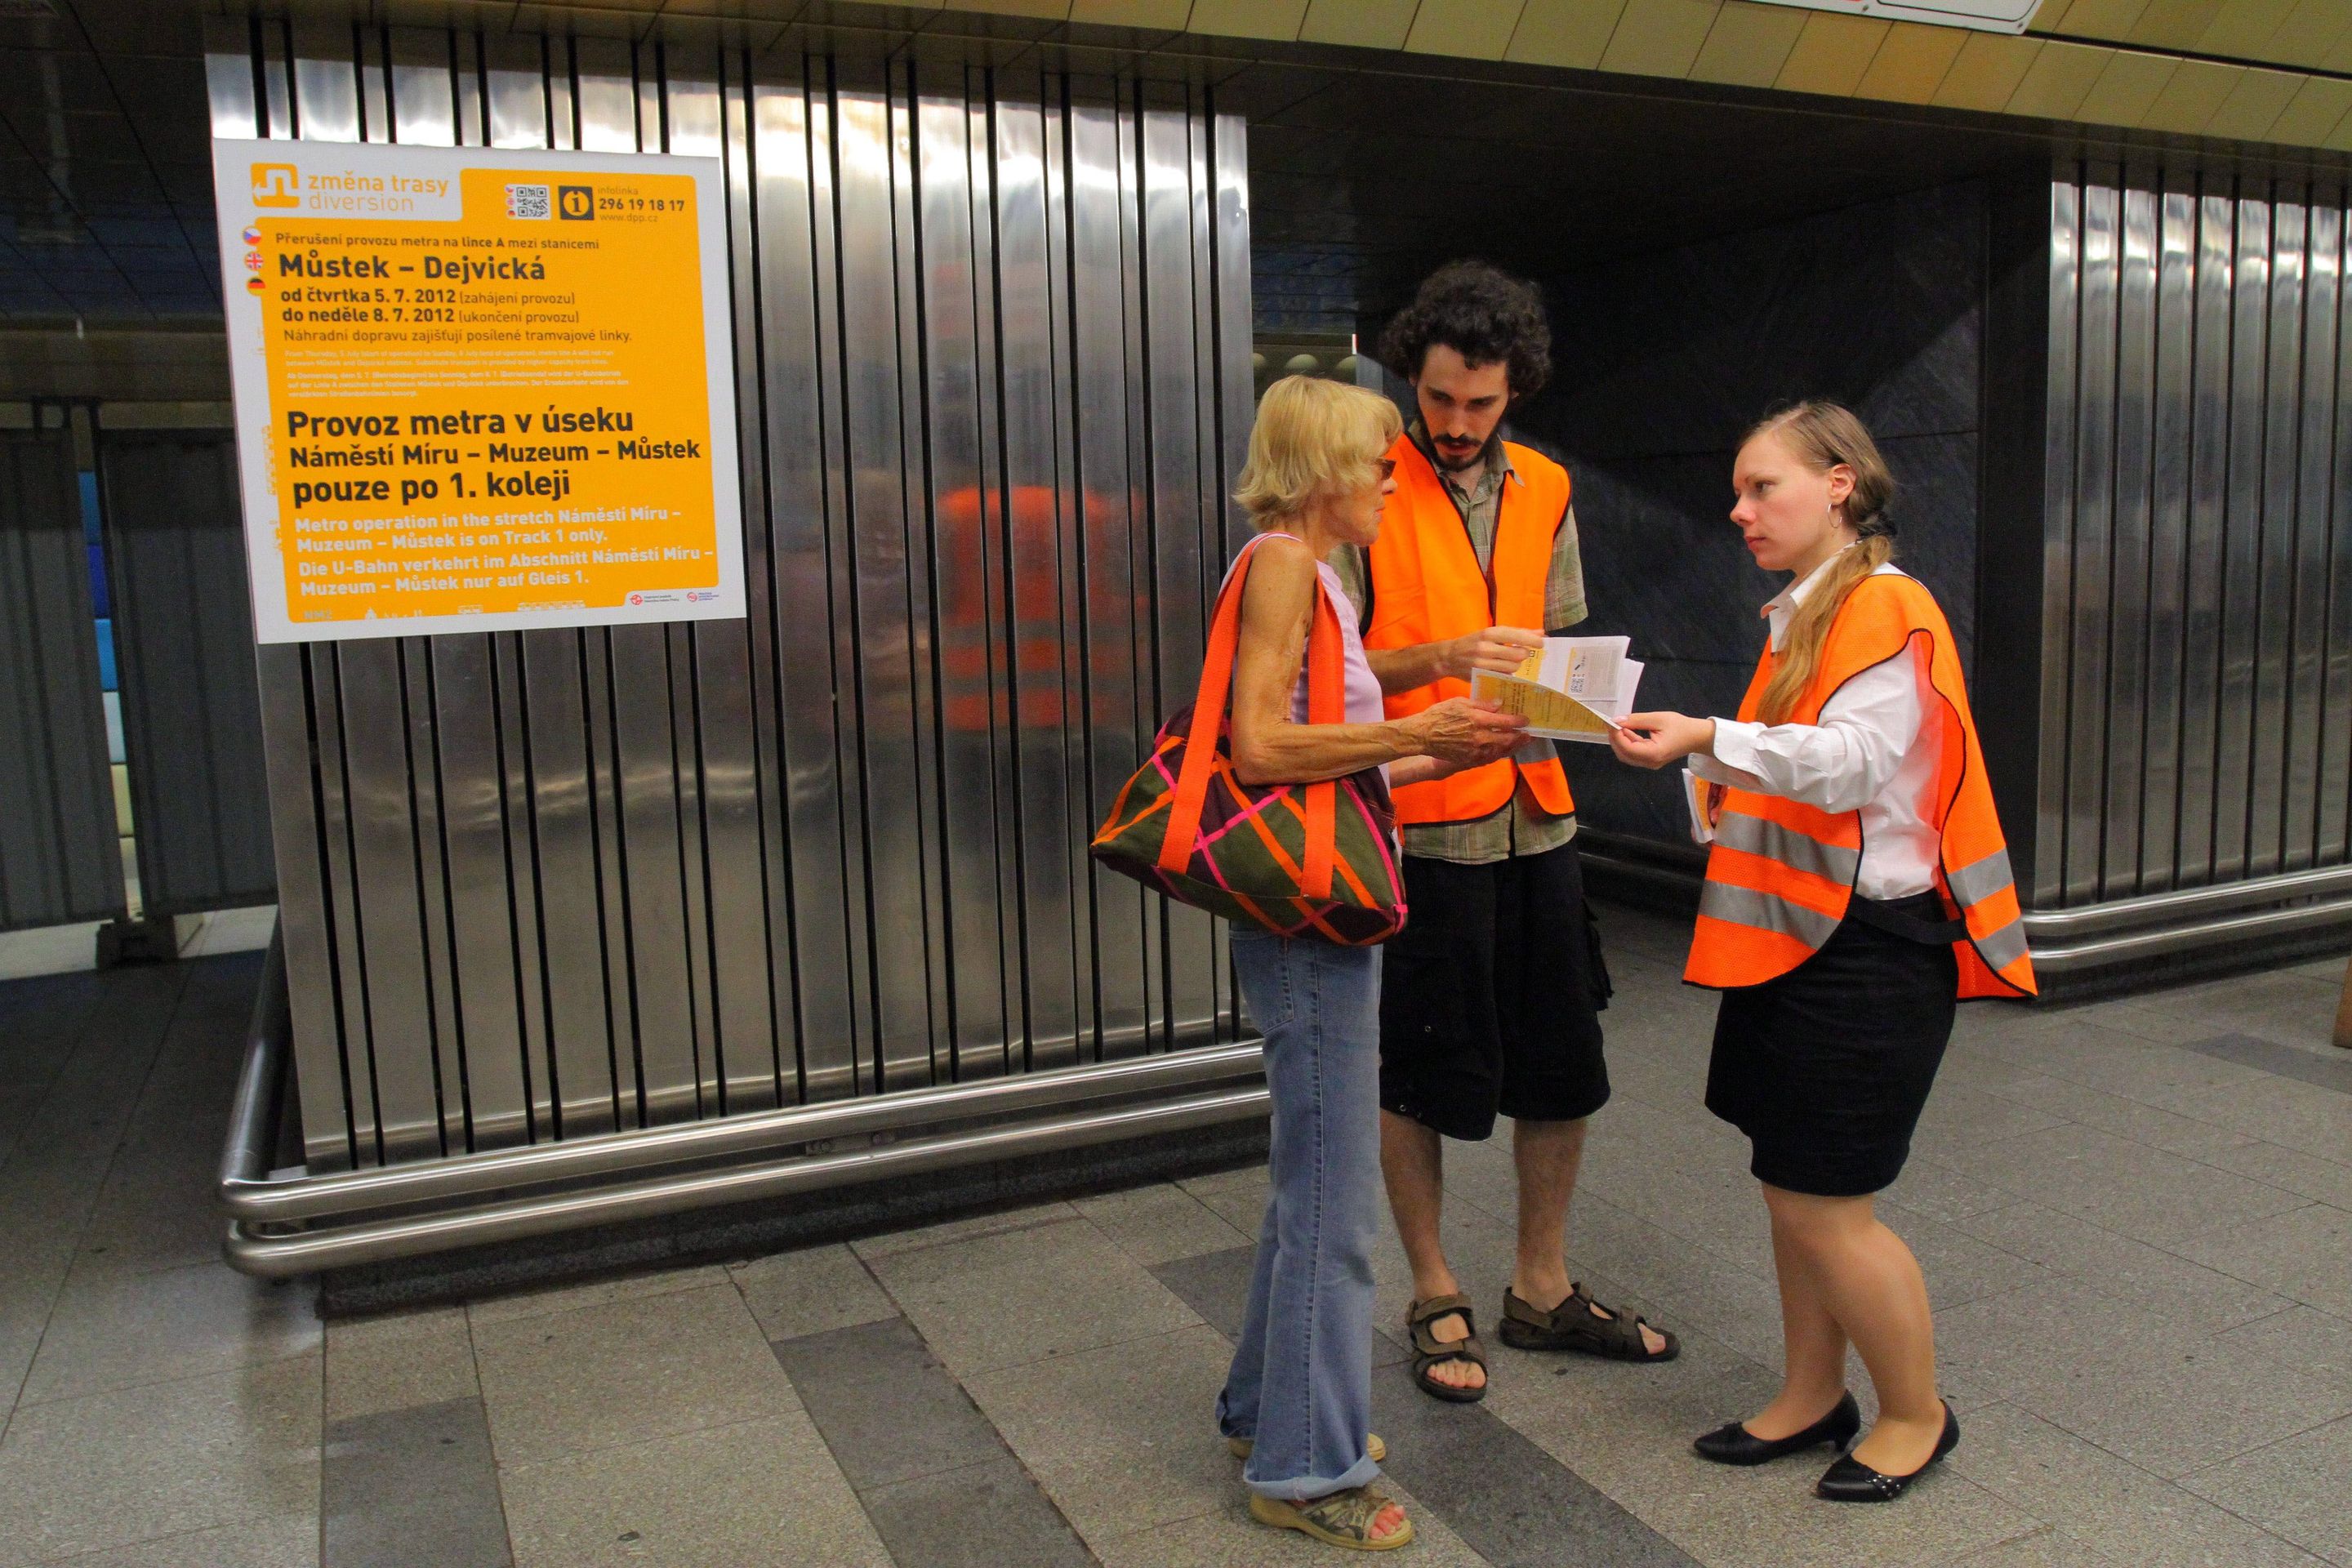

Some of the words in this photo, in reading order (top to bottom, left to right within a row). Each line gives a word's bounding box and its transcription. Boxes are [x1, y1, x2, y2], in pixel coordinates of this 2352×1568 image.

[308, 171, 384, 191] změna
[391, 175, 448, 198] trasy
[598, 186, 639, 195] infolinka
[310, 192, 414, 212] diversion
[599, 198, 623, 209] 296
[629, 198, 644, 210] 19
[649, 199, 664, 211] 18
[670, 200, 684, 211] 17
[599, 213, 657, 223] www.dpp.cz
[275, 233, 341, 245] Přerušení
[346, 237, 397, 247] provozu
[401, 238, 439, 247] metra
[462, 237, 492, 247] lince
[497, 238, 505, 247] A
[509, 240, 537, 248] mezi
[541, 239, 599, 249] stanicemi
[279, 250, 390, 278] Můstek
[425, 256, 545, 284] Dejvická
[281, 287, 301, 301] od
[307, 287, 370, 302] čtvrtka
[375, 288, 390, 302] 5.
[394, 288, 409, 302] 7.
[415, 289, 455, 303] 2012
[461, 292, 516, 305] (zahájení
[522, 292, 574, 306] provozu)
[283, 308, 303, 322] do
[309, 307, 368, 322] neděle
[373, 308, 388, 322] 8.
[393, 308, 408, 322] 7.
[414, 308, 454, 322] 2012
[460, 310, 521, 324] (ukončení
[527, 311, 578, 325] provozu)
[283, 329, 348, 341] Náhradní
[353, 330, 407, 344] dopravu
[412, 329, 461, 344] zajišťují
[467, 329, 521, 343] posílené
[526, 331, 595, 343] tramvajové
[600, 330, 632, 343] linky.
[287, 411, 399, 437] Provoz
[411, 410, 505, 435] metra
[514, 414, 532, 433] v
[542, 405, 632, 432] úseku
[290, 443, 393, 468] Náměstí
[403, 443, 458, 465] Míru
[489, 443, 588, 462] Muzeum
[617, 436, 700, 460] Můstek
[293, 480, 390, 509] pouze
[401, 479, 438, 506] po
[451, 473, 475, 497] 1.
[487, 470, 569, 501] koleji
[295, 519, 348, 532] Metro
[353, 515, 438, 533] operation
[442, 514, 458, 527] in
[462, 513, 490, 527] the
[495, 510, 554, 525] stretch
[559, 507, 626, 523] Náměstí
[630, 506, 668, 520] Míru
[296, 538, 372, 552] Muzeum
[392, 532, 455, 549] Můstek
[460, 533, 474, 546] is
[479, 535, 499, 546] on
[503, 530, 550, 544] Track
[556, 529, 564, 542] 1
[569, 528, 608, 544] only.
[299, 562, 327, 577] Die
[332, 559, 399, 575] U-Bahn
[403, 556, 479, 572] verkehrt
[483, 555, 505, 568] im
[510, 551, 588, 567] Abschnitt
[592, 547, 659, 563] Náměstí
[663, 546, 700, 560] Míru
[301, 581, 376, 596] Muzeum
[395, 575, 458, 592] Můstek
[463, 577, 492, 588] nur
[497, 572, 524, 586] auf
[528, 571, 571, 586] Gleis
[575, 570, 589, 583] 1.
